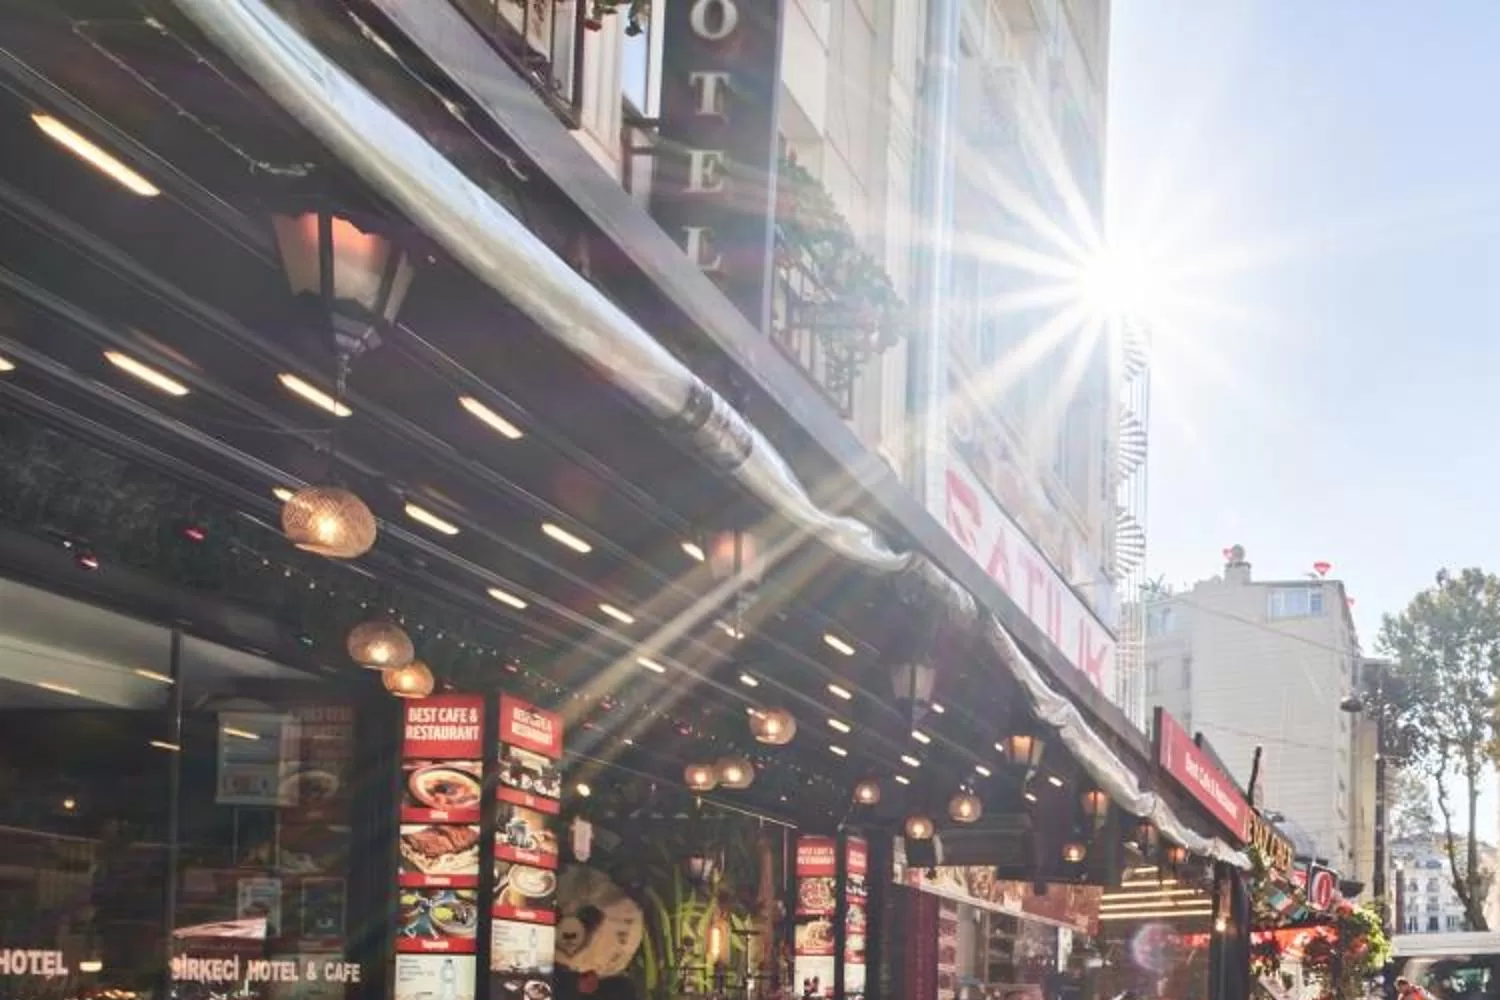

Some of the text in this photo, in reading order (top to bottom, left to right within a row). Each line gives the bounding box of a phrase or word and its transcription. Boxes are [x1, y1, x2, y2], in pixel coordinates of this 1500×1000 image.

[408, 707, 437, 722] BEST
[438, 707, 467, 722] CAFE
[405, 726, 480, 741] RESTAURANT
[0, 948, 68, 976] HOTEL
[248, 960, 299, 982] HOTEL
[306, 962, 317, 980] &
[325, 962, 361, 982] CAFE
